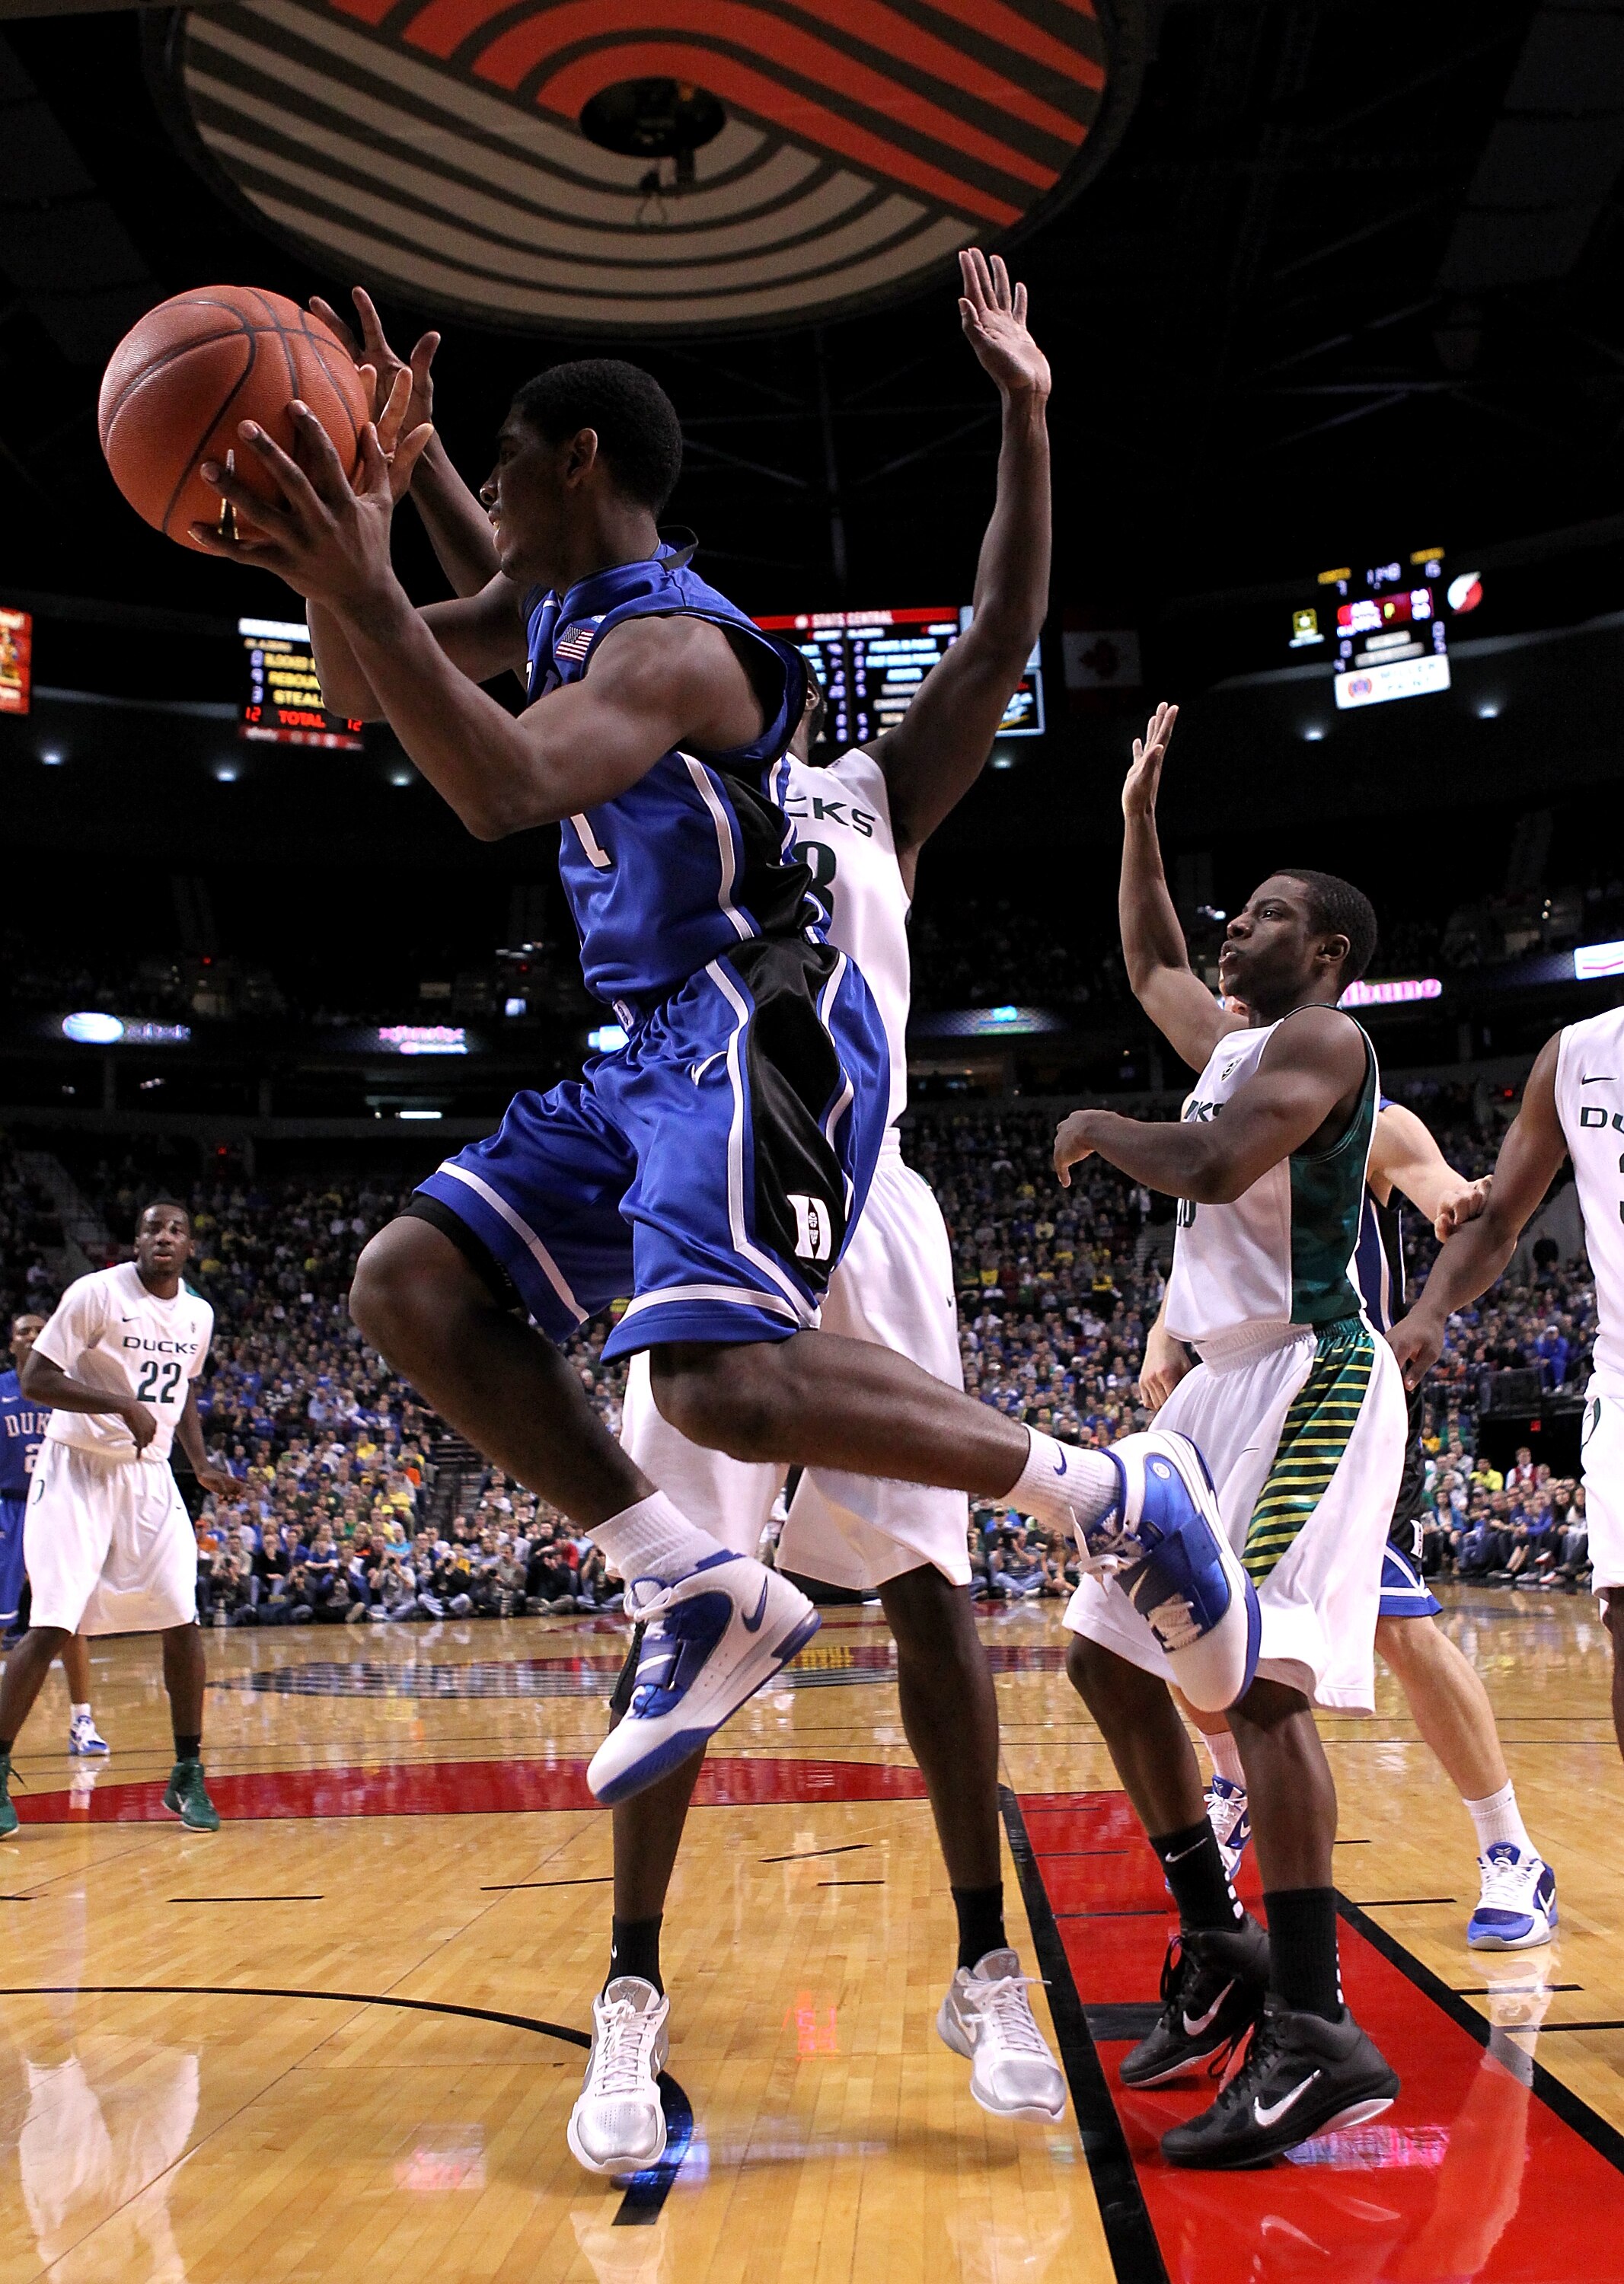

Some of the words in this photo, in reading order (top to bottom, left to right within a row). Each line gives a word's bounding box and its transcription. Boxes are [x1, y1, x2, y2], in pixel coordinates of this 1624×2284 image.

[278, 710, 327, 729] TOTAL
[122, 1335, 199, 1355] DUCKS
[137, 1360, 183, 1404] 22
